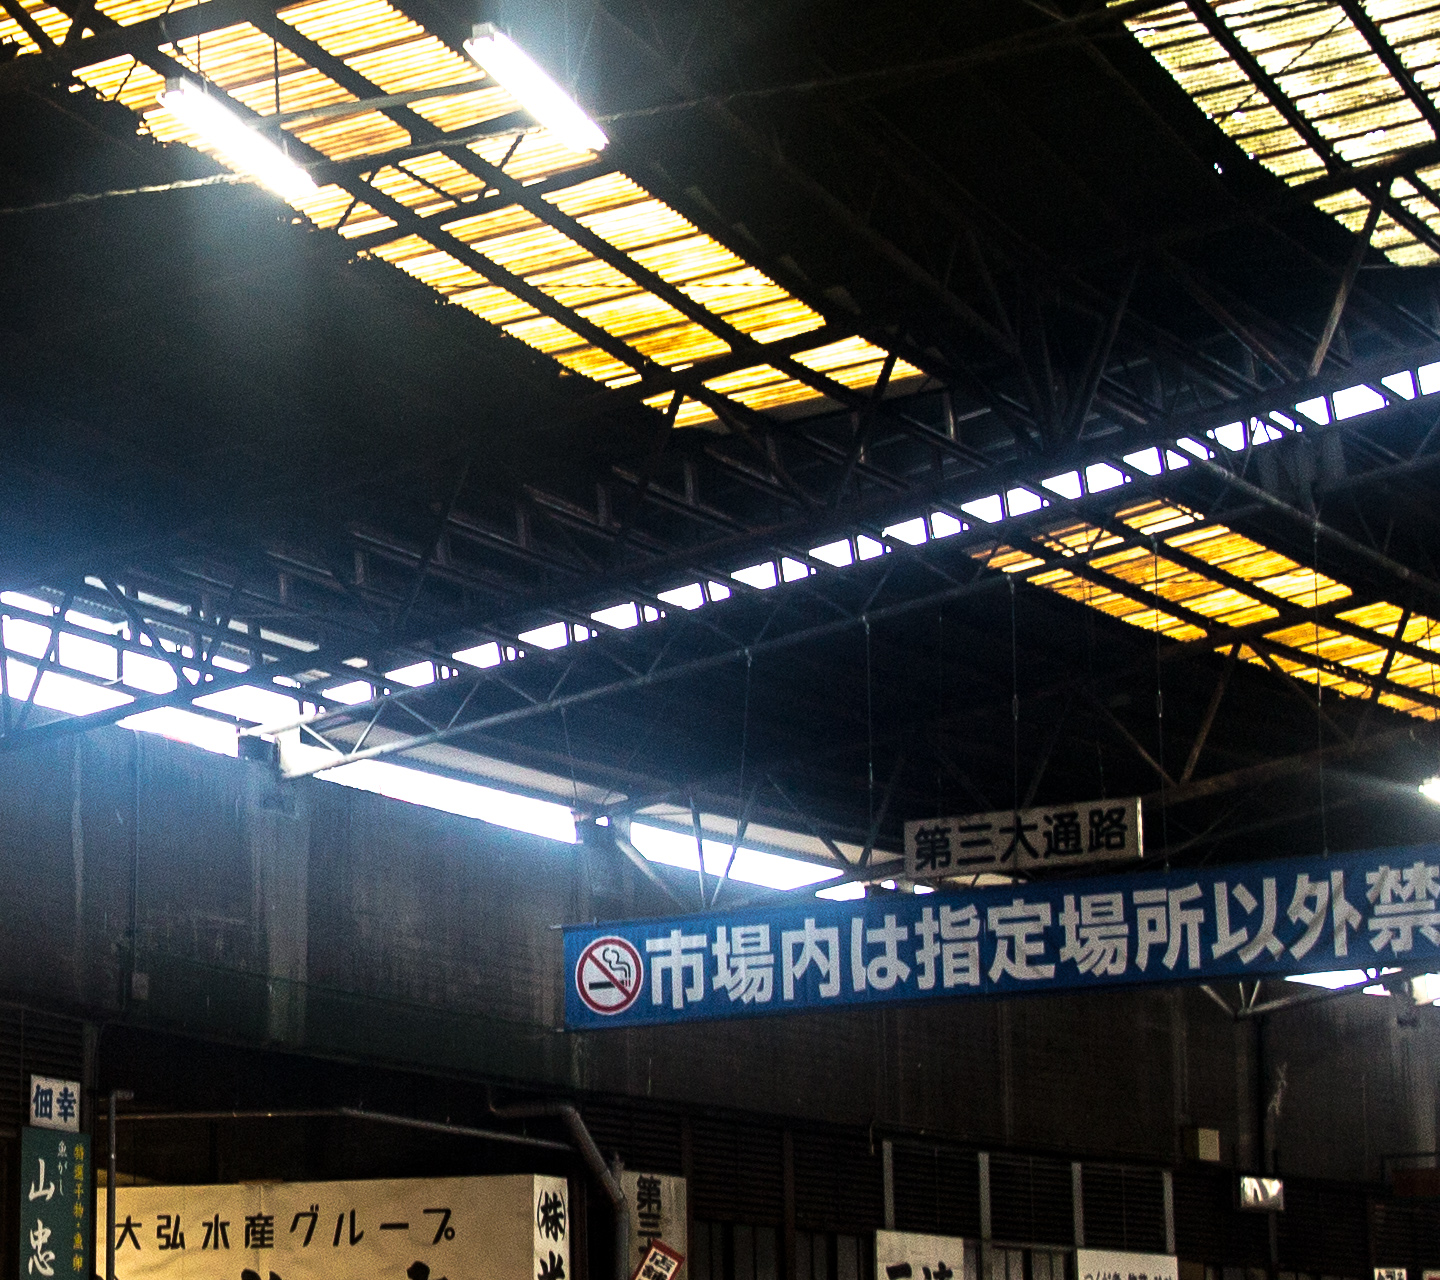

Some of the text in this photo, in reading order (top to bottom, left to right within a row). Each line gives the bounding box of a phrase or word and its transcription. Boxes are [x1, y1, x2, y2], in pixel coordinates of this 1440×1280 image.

[914, 815, 1130, 870] 第三大通路
[28, 1158, 56, 1277] 山忠
[114, 1204, 456, 1251] 大弘水産グループ
